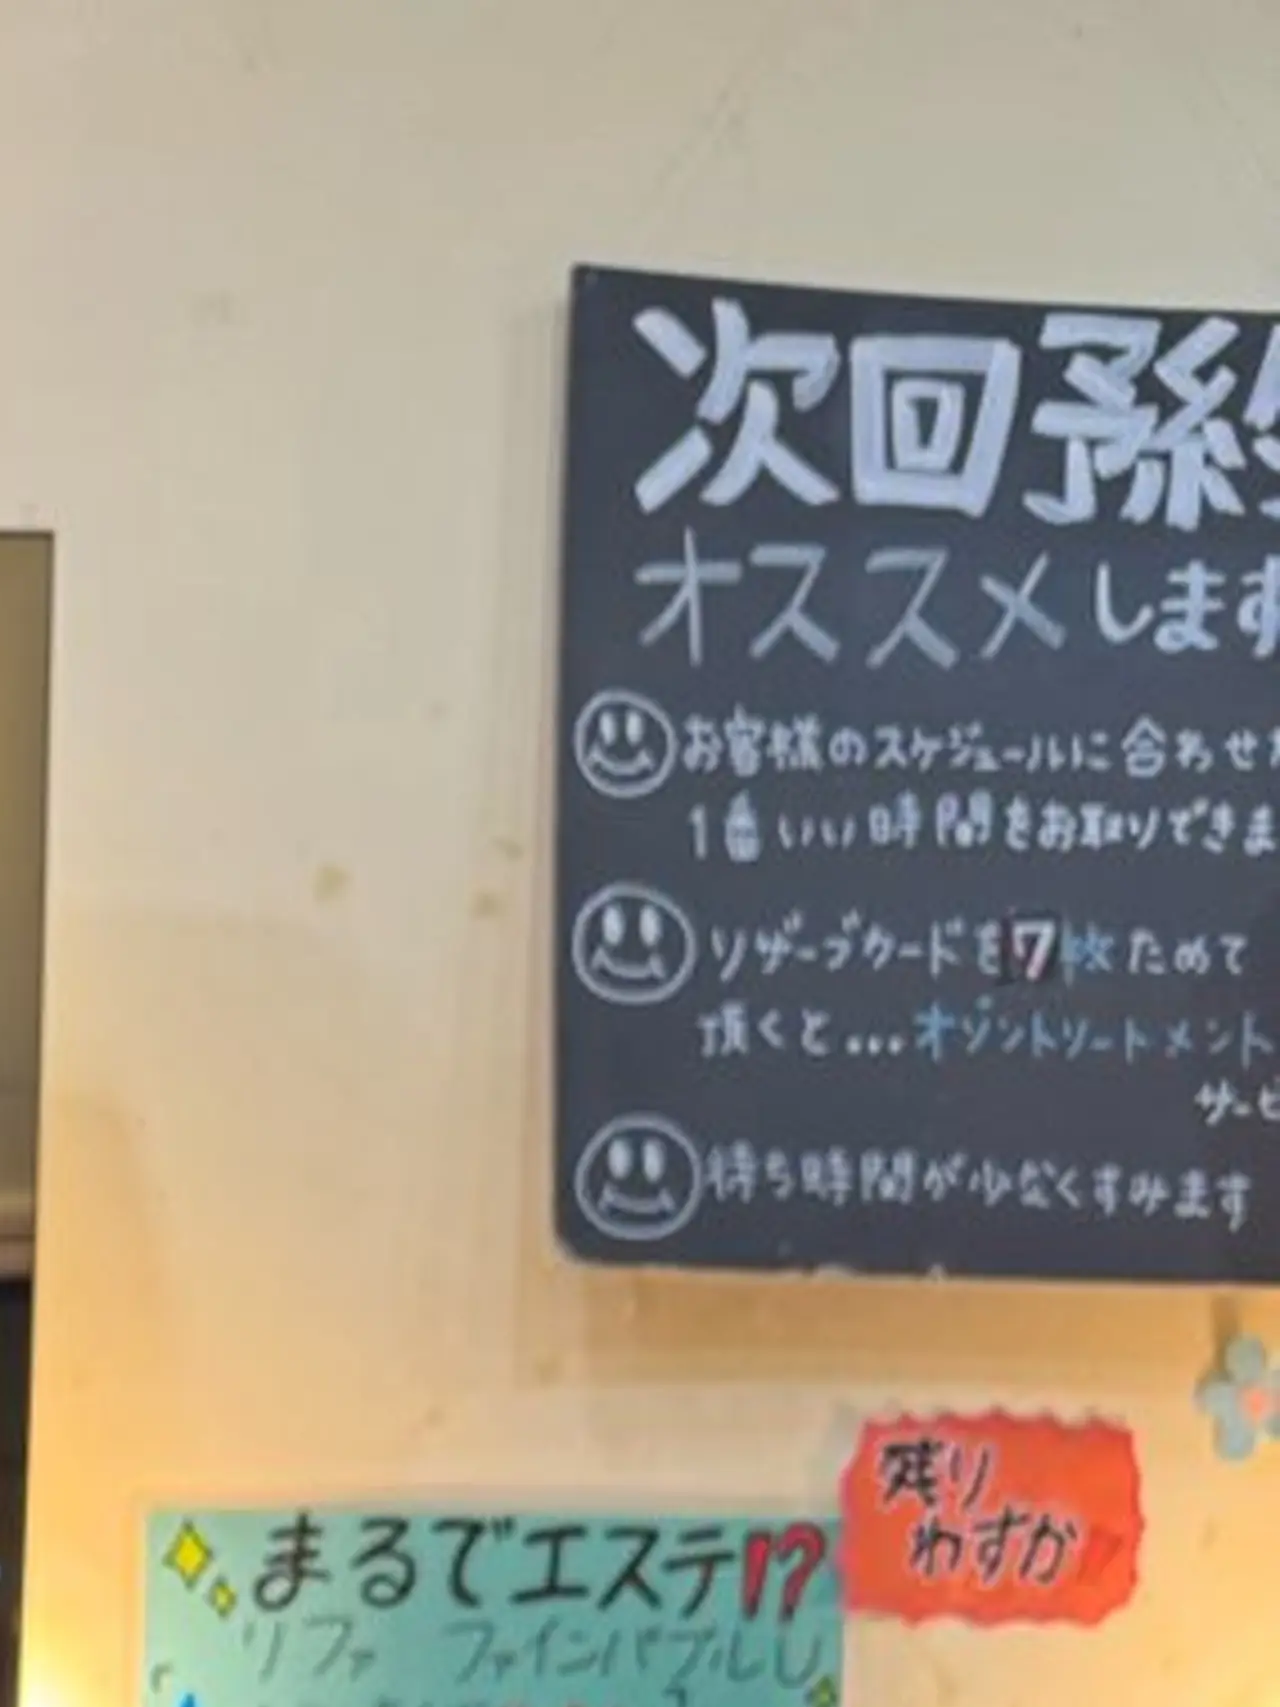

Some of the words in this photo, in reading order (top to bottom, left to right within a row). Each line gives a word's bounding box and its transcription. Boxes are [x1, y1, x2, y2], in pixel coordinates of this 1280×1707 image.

[682, 700, 1280, 778] お客様のスケジュールに合わせ
